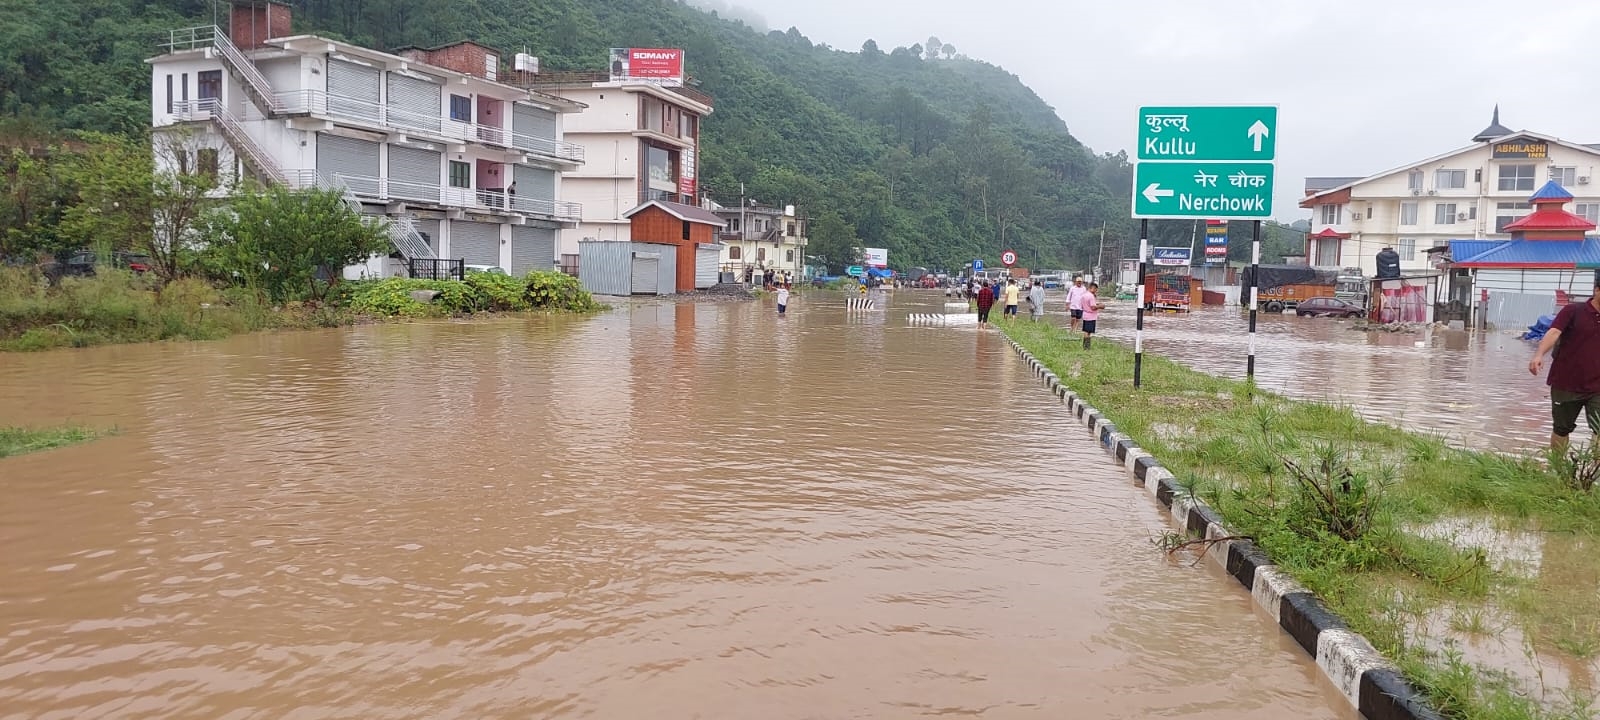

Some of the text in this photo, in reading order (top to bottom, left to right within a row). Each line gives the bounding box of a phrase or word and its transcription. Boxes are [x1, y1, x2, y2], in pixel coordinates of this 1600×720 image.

[1145, 114, 1190, 132] कुल्लू
[1145, 137, 1196, 155] Kullu
[1496, 144, 1546, 153] ABHILASHI
[1193, 169, 1266, 188] नेर चौक
[1179, 193, 1265, 211] Nerchowk
